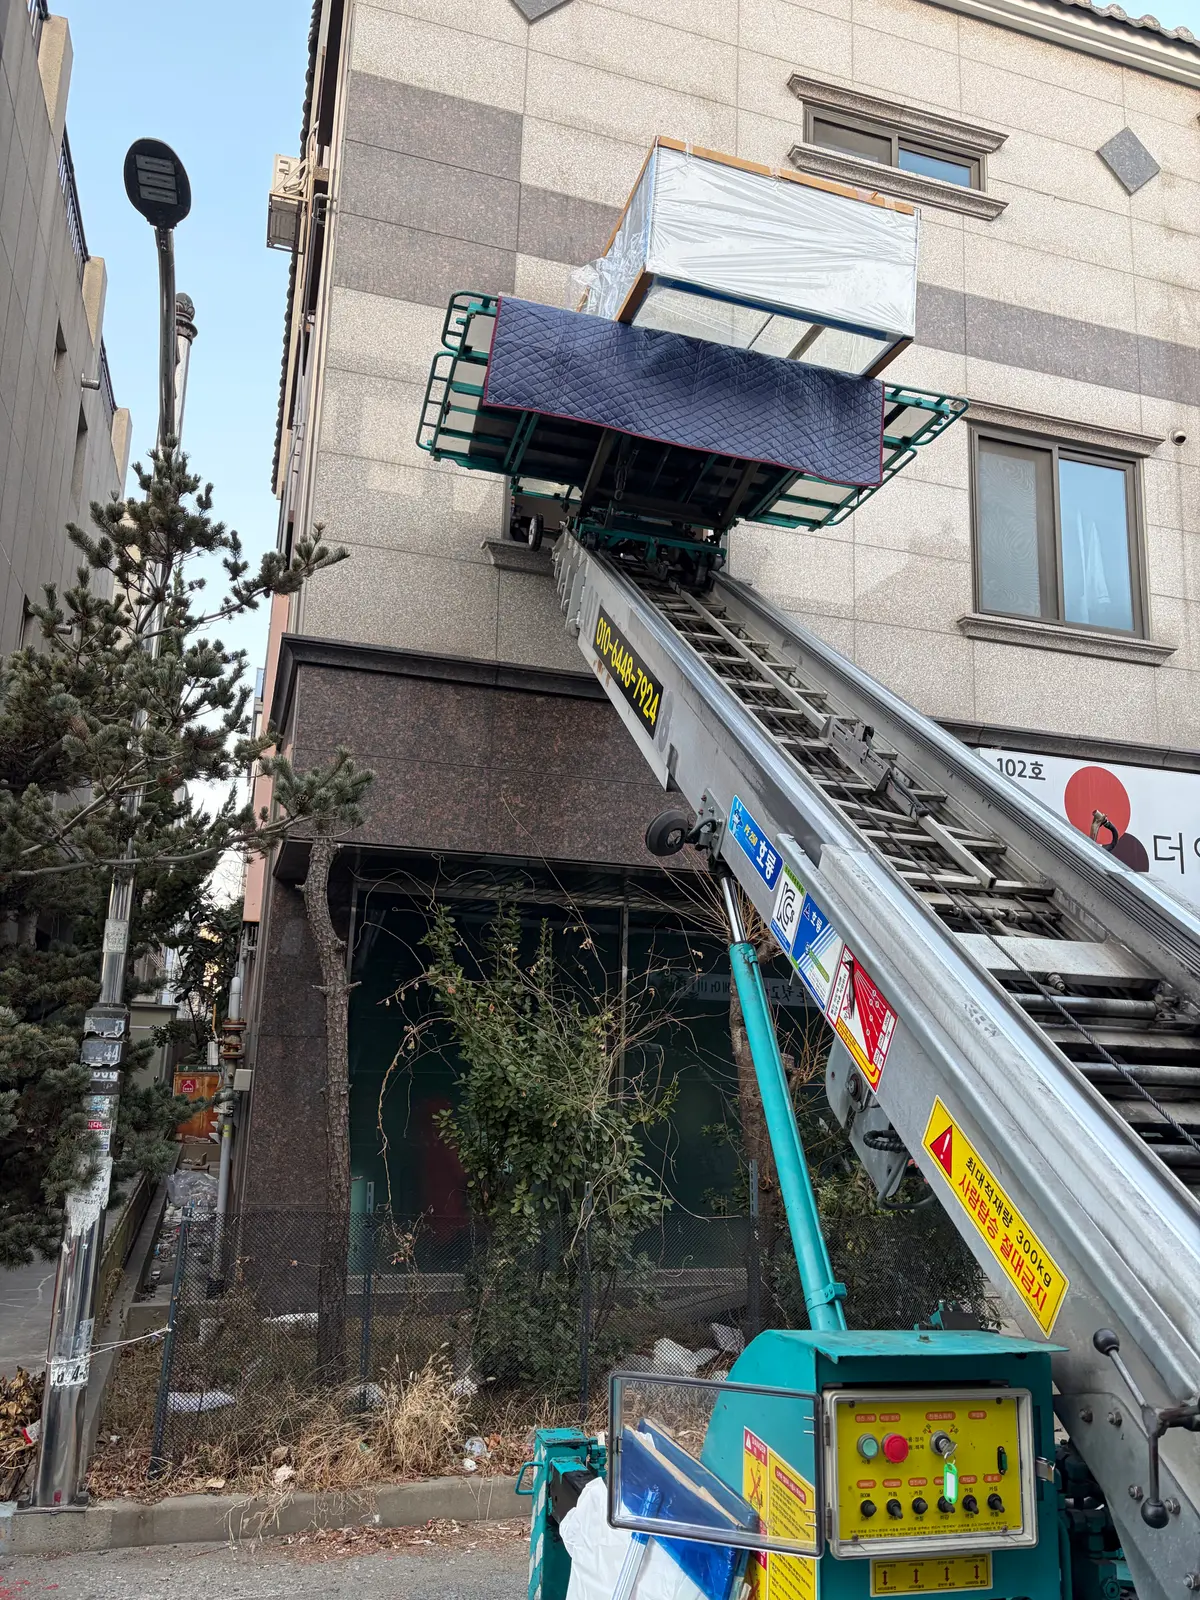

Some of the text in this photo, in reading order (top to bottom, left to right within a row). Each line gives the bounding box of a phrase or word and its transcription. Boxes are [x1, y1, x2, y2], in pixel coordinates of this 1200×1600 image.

[596, 616, 660, 726] 010-6448-7924
[996, 757, 1047, 781] 102호
[958, 1173, 1048, 1313] 사람탑승 절대금지
[965, 1156, 1052, 1289] 최대적재량 300kg
